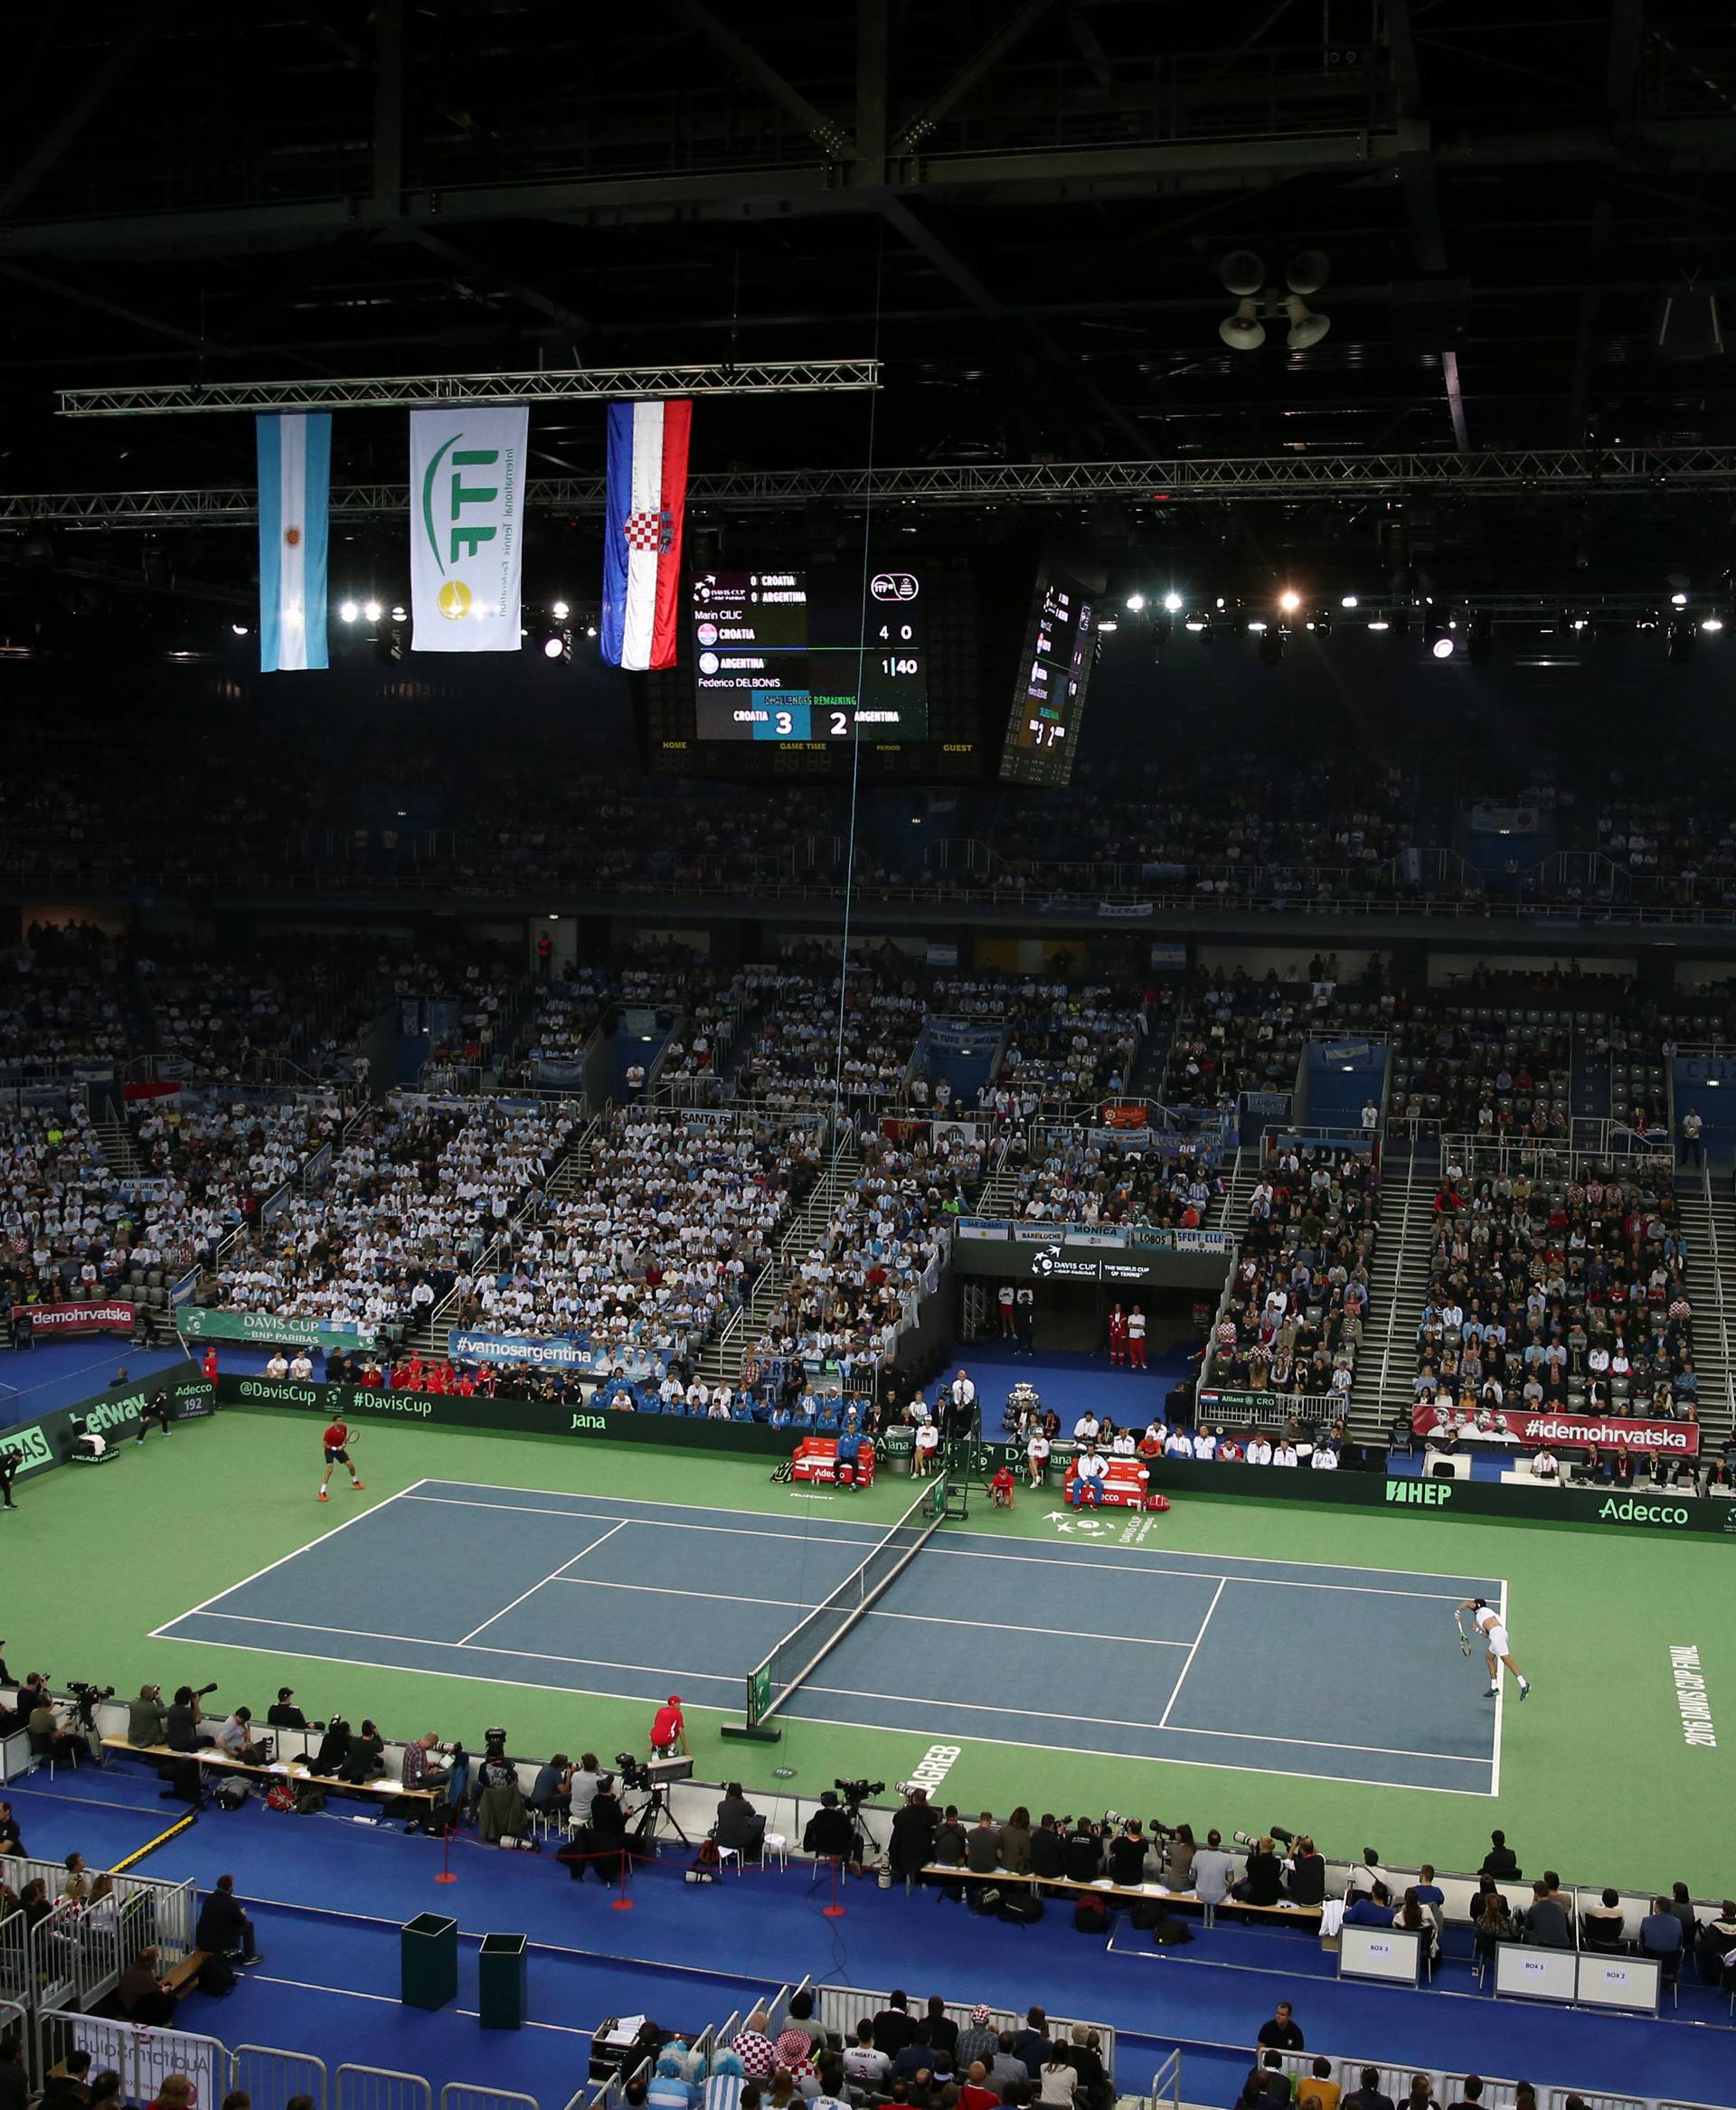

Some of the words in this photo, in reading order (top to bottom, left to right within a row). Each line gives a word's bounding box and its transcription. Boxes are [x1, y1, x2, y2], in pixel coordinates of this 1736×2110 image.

[761, 576, 795, 586] CROATIA
[762, 591, 807, 602] ARGENTINA
[694, 610, 718, 619] Marin
[719, 610, 742, 619] CILIC
[719, 628, 755, 639] CROATIA
[879, 625, 889, 639] 4
[901, 625, 912, 639] 0
[721, 658, 764, 668] ARGENTINA
[896, 660, 918, 674] 40
[698, 678, 734, 687] Federico
[735, 678, 780, 687] DELBONIS
[814, 696, 856, 705] REMAINING
[733, 711, 769, 721] CROATIA
[775, 711, 793, 734] 3
[854, 711, 899, 722] ARGENTINA
[830, 712, 847, 734] 2
[663, 741, 686, 749] HOME
[682, 1113, 716, 1125] SANTA
[1074, 1225, 1118, 1237] MONICA
[1140, 1232, 1166, 1245] LOBOS
[1053, 1261, 1077, 1269] DAVIS
[244, 1315, 285, 1331] DAVIS
[289, 1319, 319, 1333] CUP
[250, 1331, 273, 1340] BNP
[275, 1333, 319, 1344] PARIBAS
[457, 1337, 591, 1363] #vamosargentina
[175, 1384, 212, 1396] Adecco
[240, 1381, 316, 1405] @DavisCup
[184, 1398, 203, 1410] 192
[354, 1392, 431, 1417] #DavisCup
[1221, 1395, 1244, 1403] Allianz
[571, 1413, 606, 1430] Jana
[1524, 1418, 1686, 1448] #idemohrvatska
[71, 1454, 99, 1463] HEAD
[99, 1449, 119, 1462] HEAD
[1408, 1482, 1452, 1505] HEP
[1599, 1498, 1689, 1524] Adecco
[1669, 1645, 1701, 1670] FINAL
[1674, 1670, 1705, 1690] CUP
[1676, 1690, 1712, 1719] DAVIS
[1682, 1720, 1717, 1747] 2016
[906, 1745, 961, 1800] AGREB
[851, 2051, 877, 2059] CROATIA
